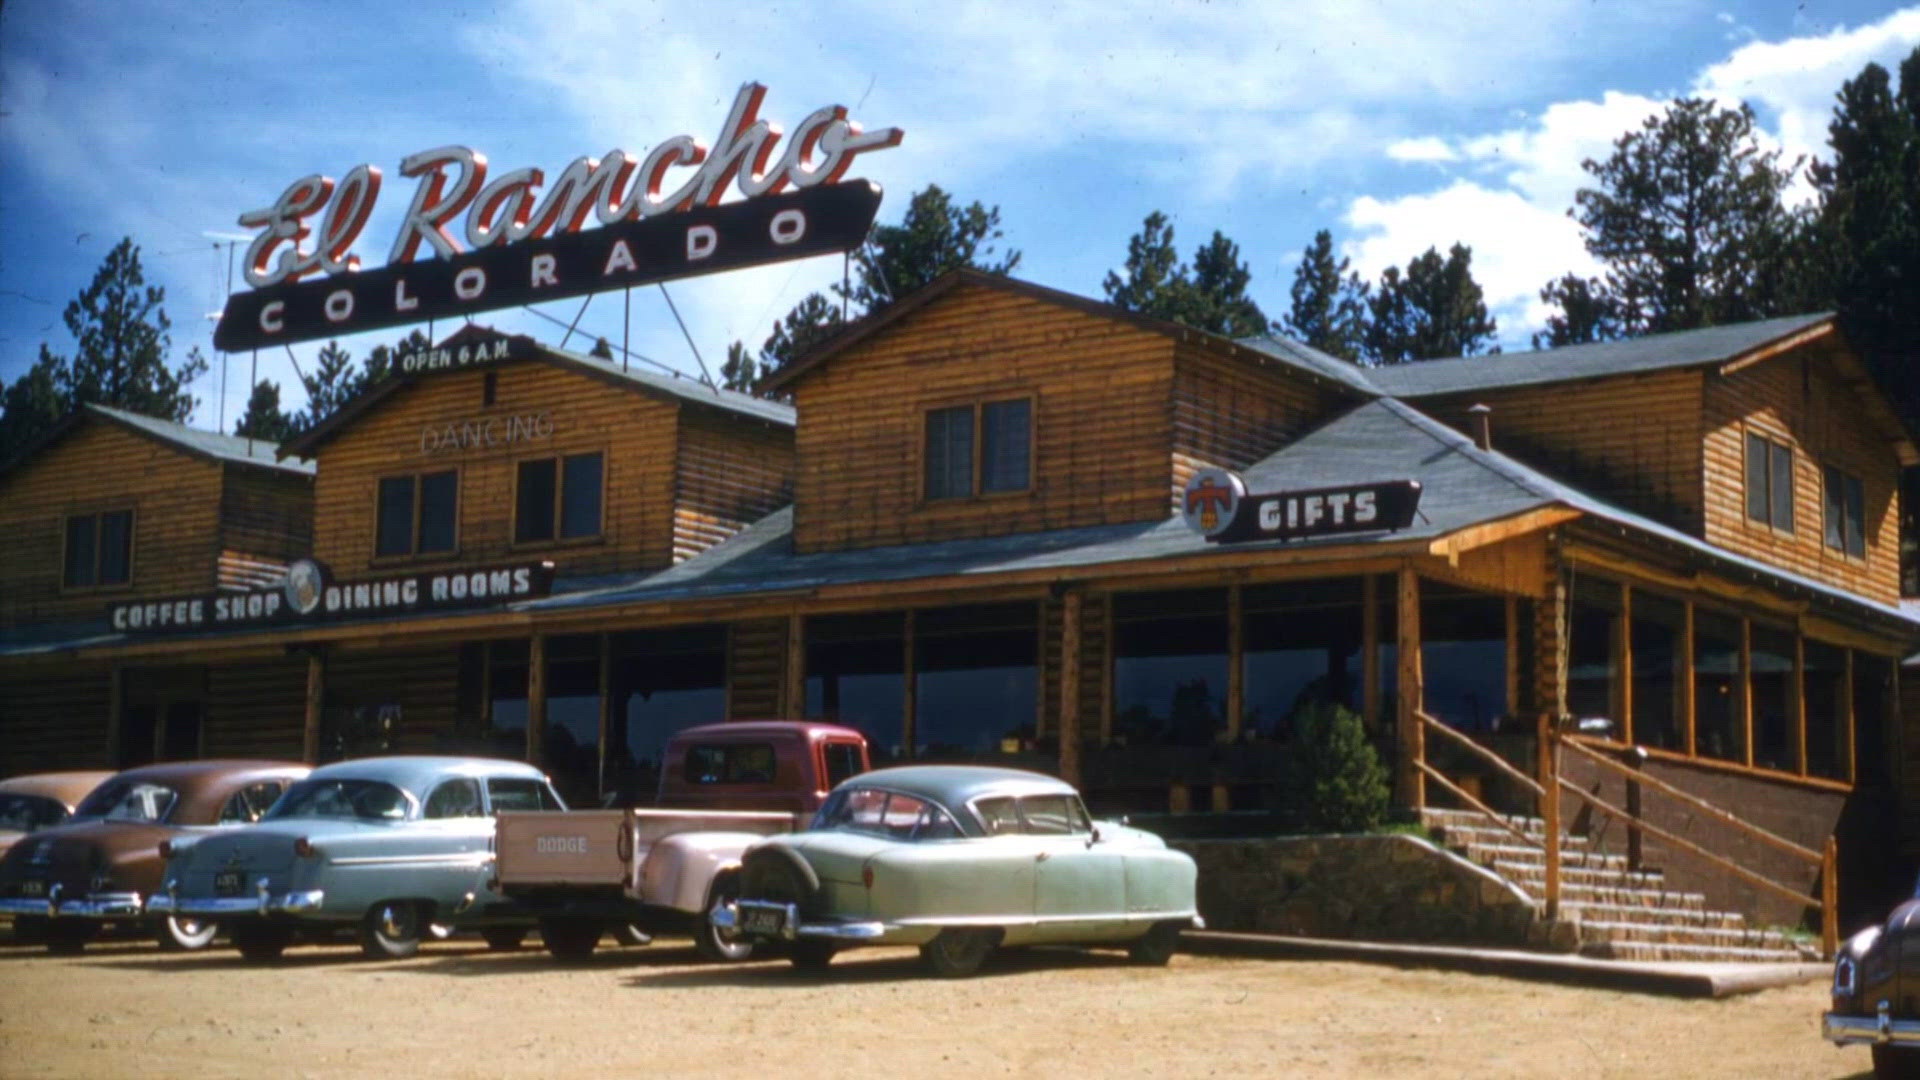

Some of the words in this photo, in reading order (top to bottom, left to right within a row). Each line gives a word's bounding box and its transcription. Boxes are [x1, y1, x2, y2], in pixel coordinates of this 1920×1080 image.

[238, 165, 382, 288] El
[388, 82, 904, 263] Rancho
[259, 209, 806, 332] COLORADO
[403, 349, 451, 372] OPEN
[458, 346, 470, 365] 6
[421, 412, 554, 454] DANCING
[1259, 491, 1377, 530] GIFTS
[325, 579, 418, 611] DINING
[432, 568, 530, 600] ROOMS
[114, 600, 203, 629] COFFEE
[215, 593, 280, 621] SHOP
[537, 836, 587, 853] DODGE
